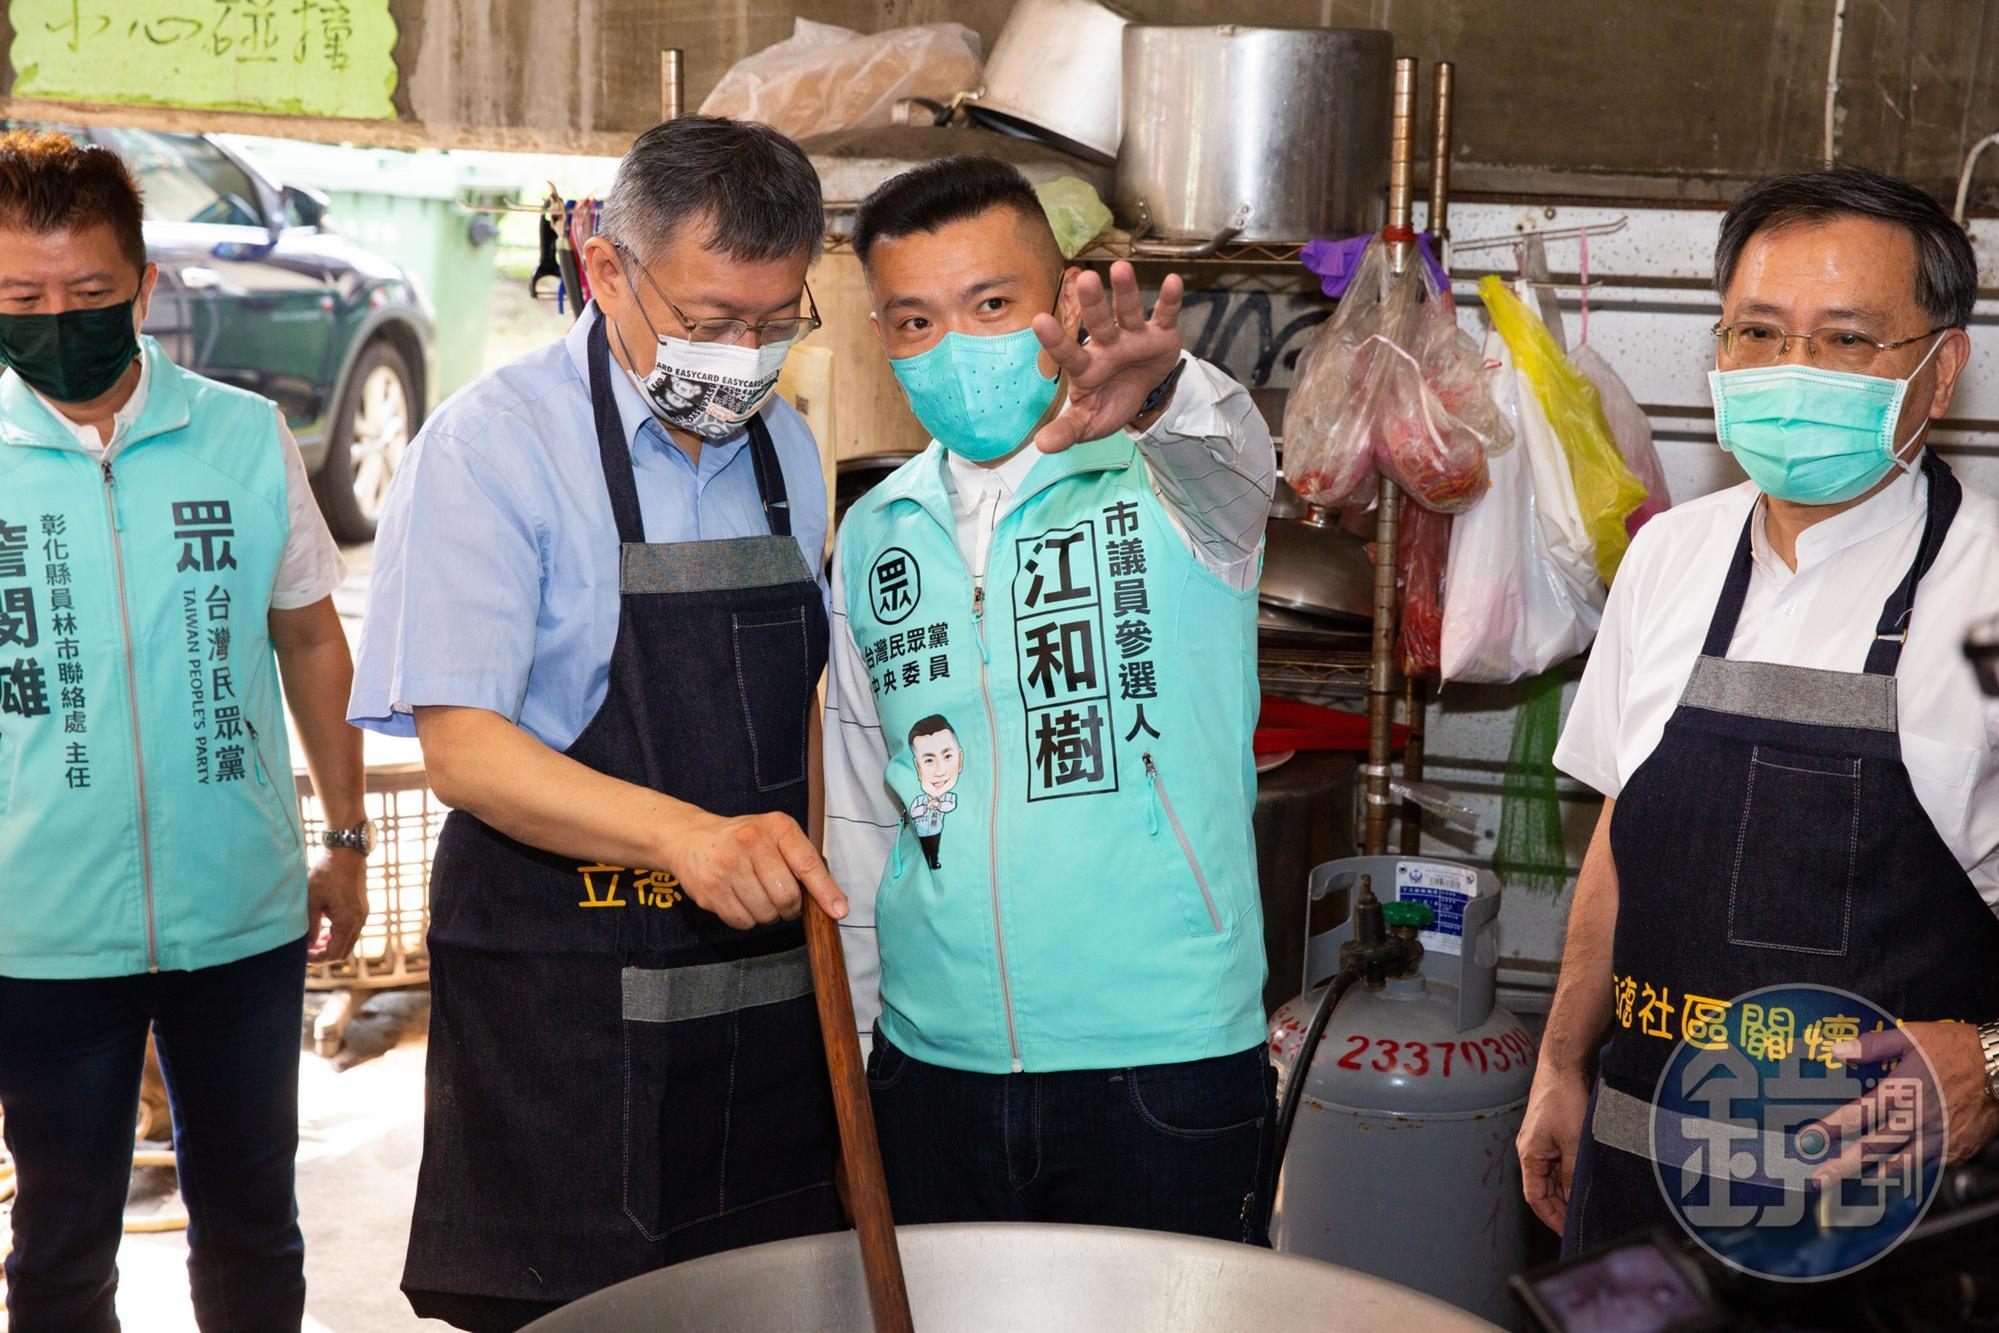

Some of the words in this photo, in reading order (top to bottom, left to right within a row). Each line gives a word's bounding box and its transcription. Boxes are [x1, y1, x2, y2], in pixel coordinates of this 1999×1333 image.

[45, 0, 353, 70] 小心碰撞
[675, 368, 720, 383] EASYCARD
[171, 499, 237, 574] 眾
[183, 586, 199, 653] TAIWAN
[876, 555, 912, 617] 眾
[865, 621, 950, 671] 台灣民眾黨
[1102, 500, 1161, 743] 市議員參選人
[205, 584, 246, 783] 台灣民眾黨
[1025, 530, 1105, 790] 江和樹
[188, 659, 206, 731] PEOPLE'S
[196, 736, 210, 785] PARTY
[577, 862, 684, 908] 立德
